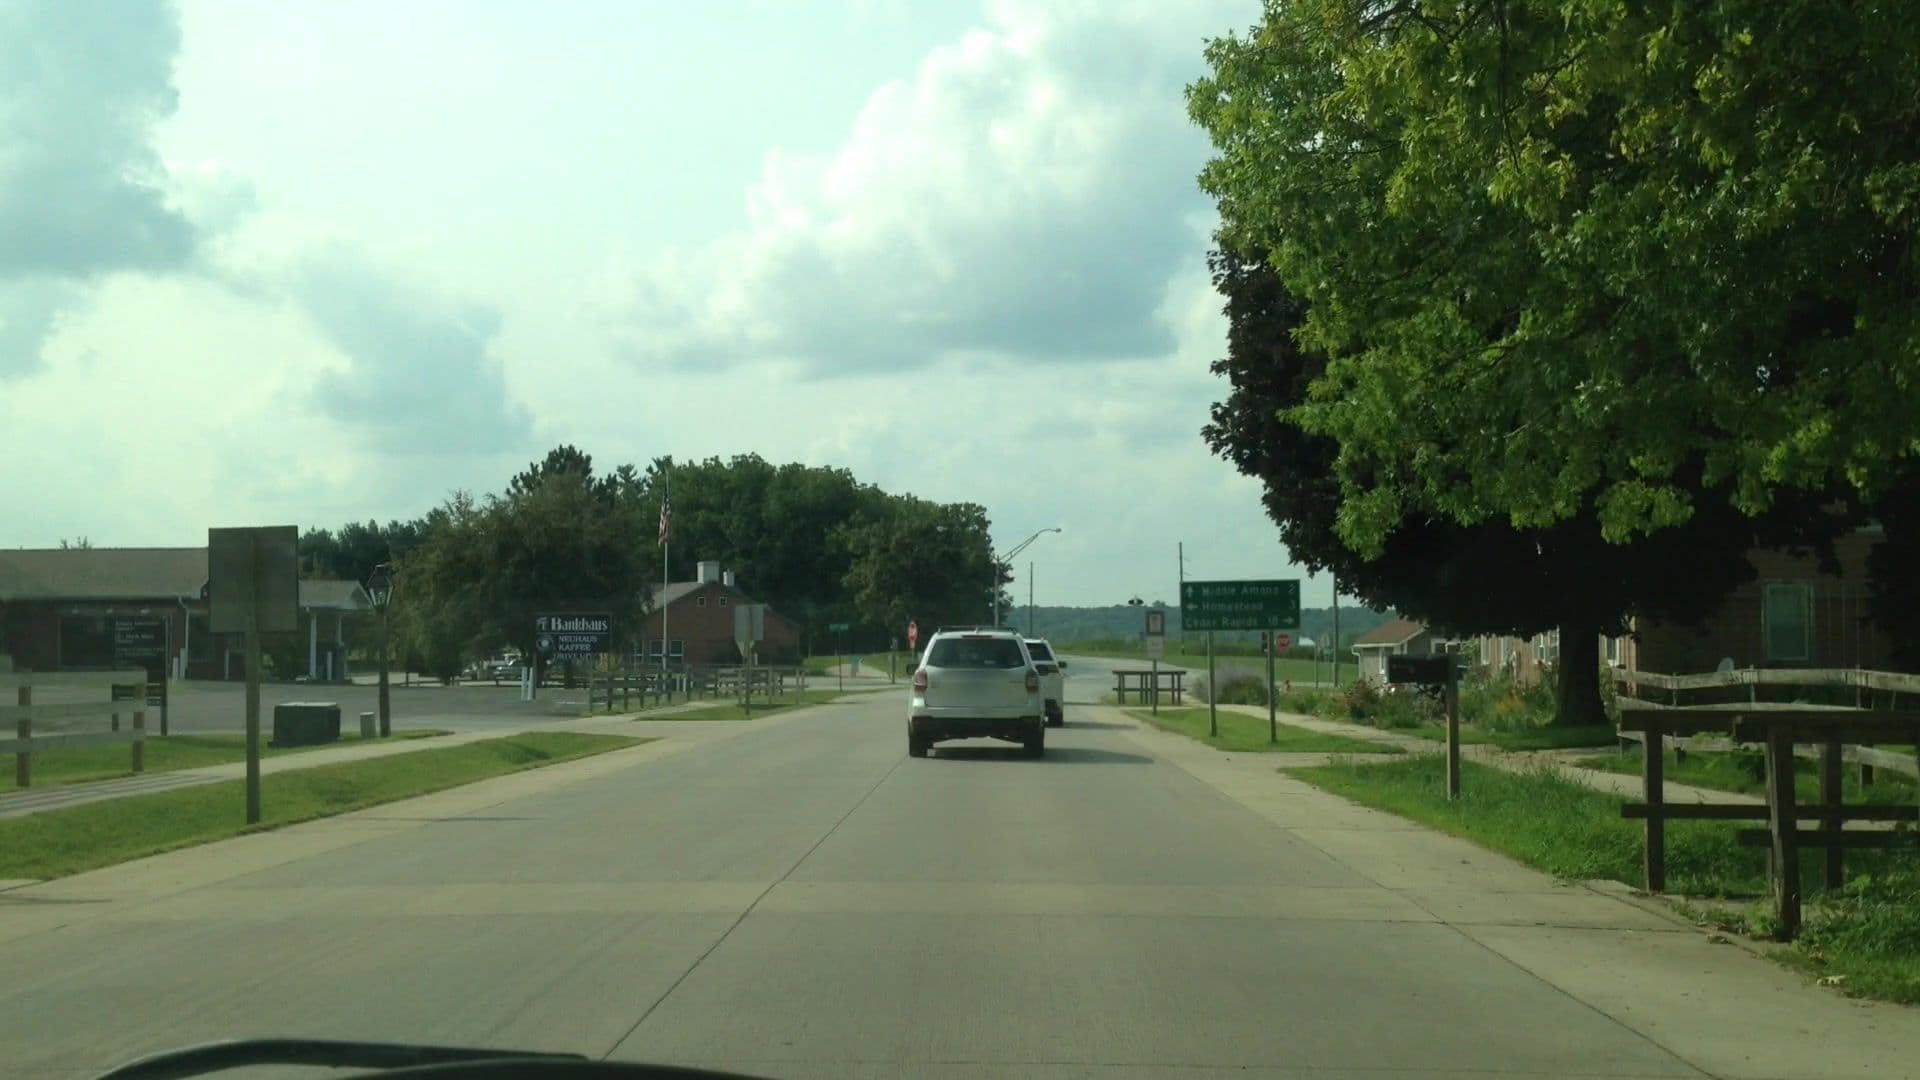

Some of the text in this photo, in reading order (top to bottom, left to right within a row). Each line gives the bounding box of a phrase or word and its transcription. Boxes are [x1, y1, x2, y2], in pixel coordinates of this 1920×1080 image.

[1241, 584, 1279, 594] Amana
[1288, 583, 1296, 594] 2
[1202, 600, 1263, 610] Homestead
[551, 617, 608, 631] Bankhaus
[1222, 616, 1258, 626] Rapids
